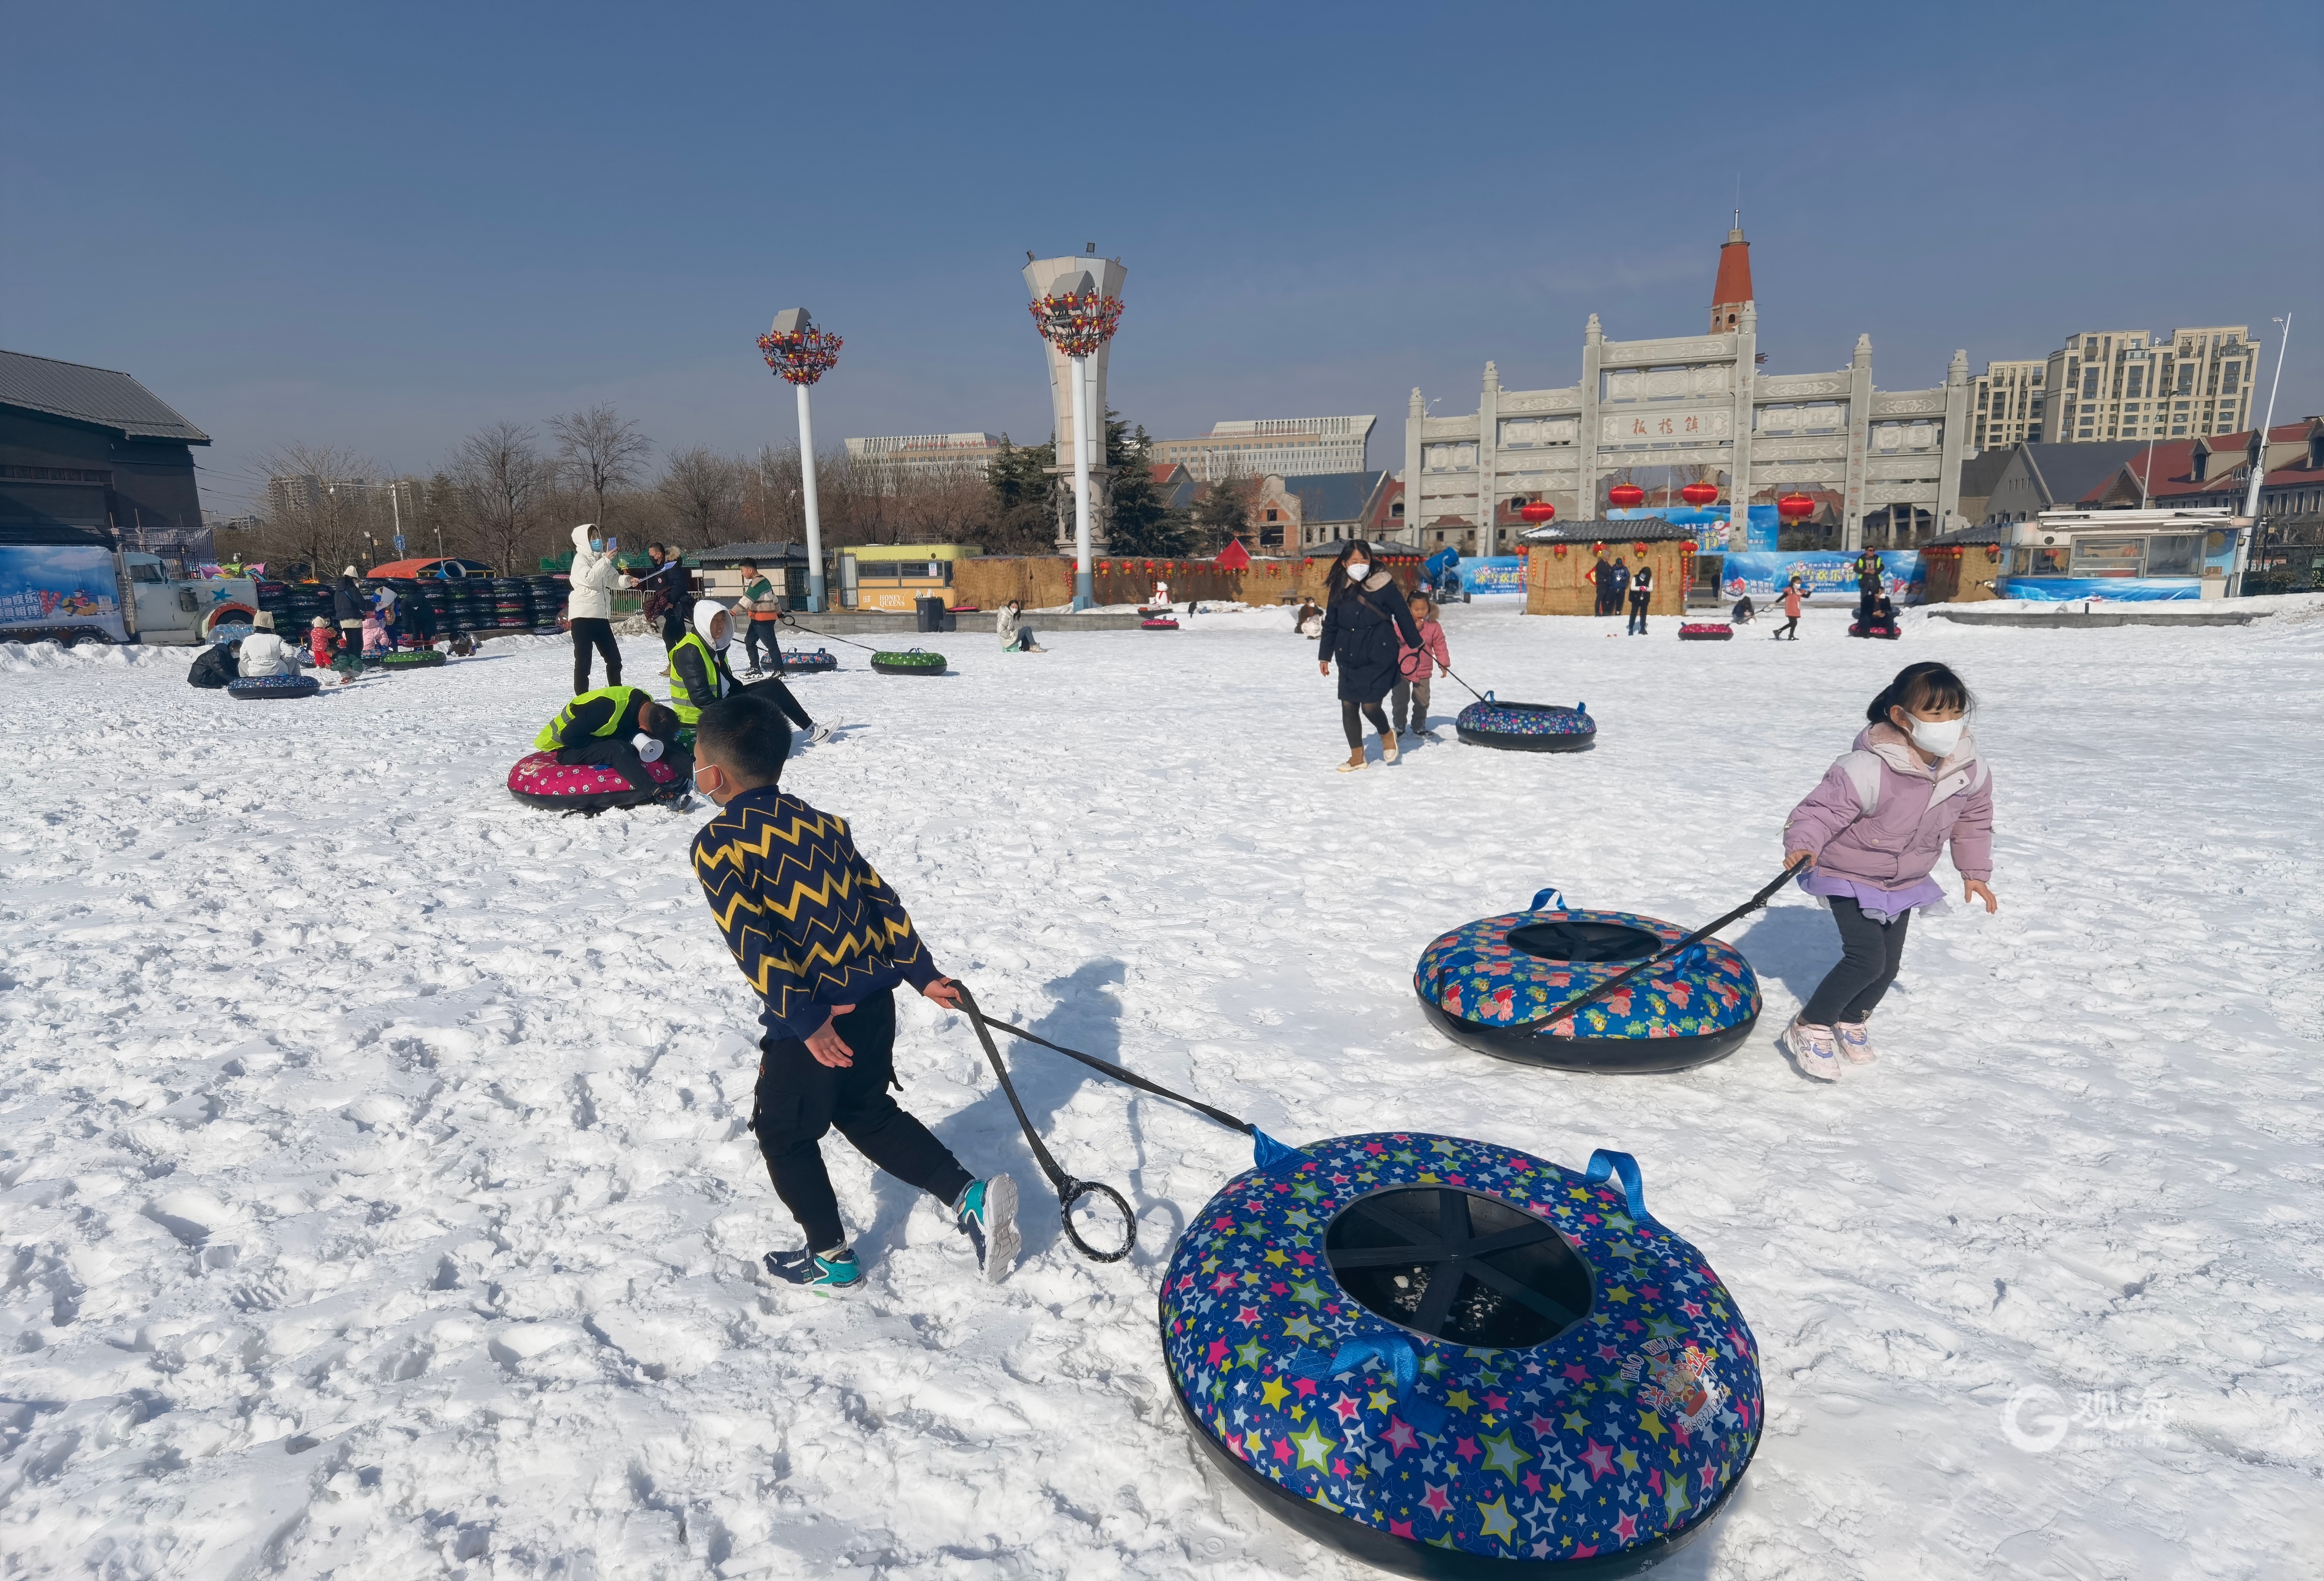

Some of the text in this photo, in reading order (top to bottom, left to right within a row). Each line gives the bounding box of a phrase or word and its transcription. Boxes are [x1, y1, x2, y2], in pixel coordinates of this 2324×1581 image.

[0, 592, 39, 606] 地娱乐
[1620, 1336, 1683, 1382] HAO HUA
